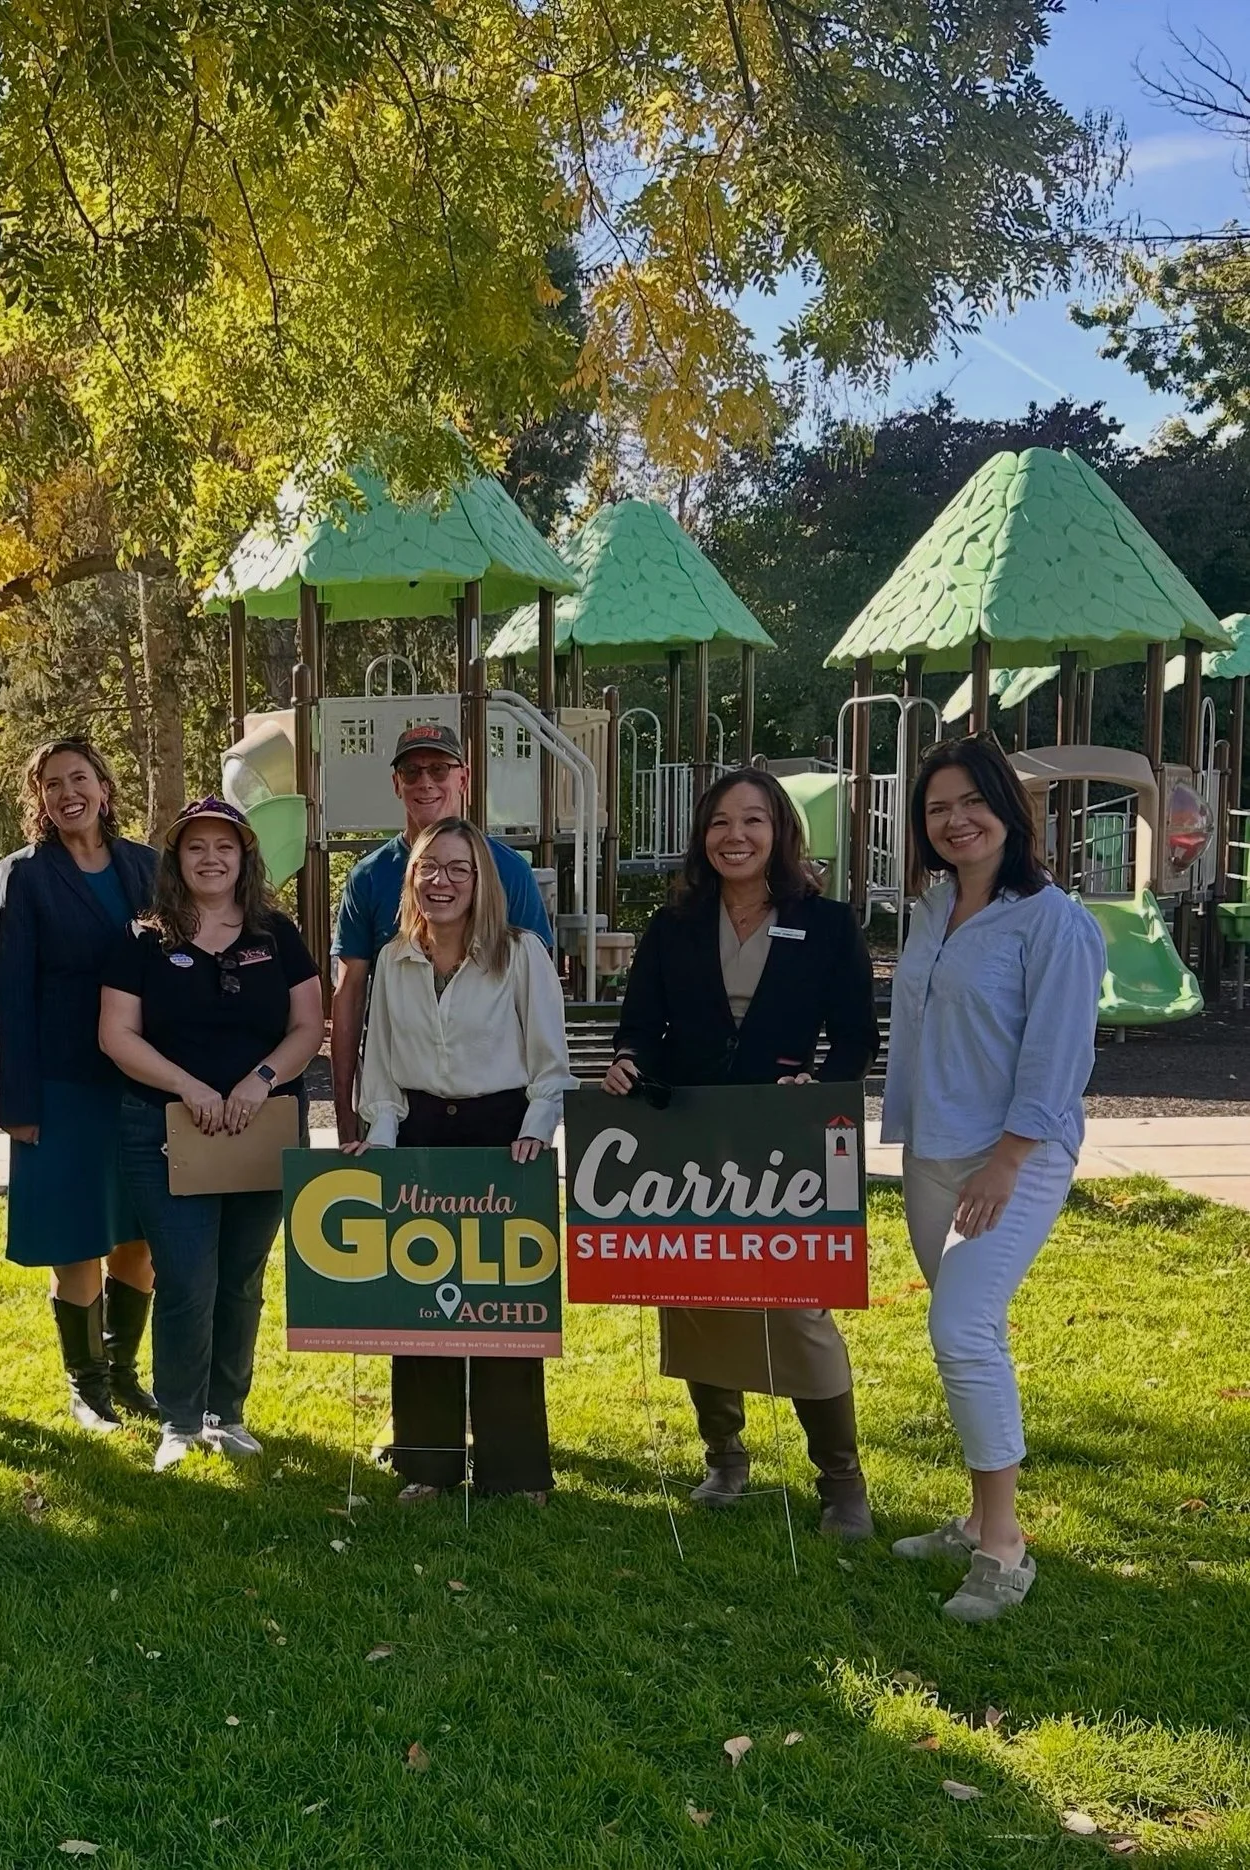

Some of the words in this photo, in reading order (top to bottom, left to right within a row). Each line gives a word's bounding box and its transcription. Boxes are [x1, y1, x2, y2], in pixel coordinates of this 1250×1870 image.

[573, 1127, 825, 1219] Carrie
[386, 1184, 517, 1215] Miranda
[290, 1169, 559, 1287] GOLD
[576, 1233, 853, 1262] SEMMELROTH
[418, 1307, 440, 1319] for
[455, 1301, 548, 1325] ACHD
